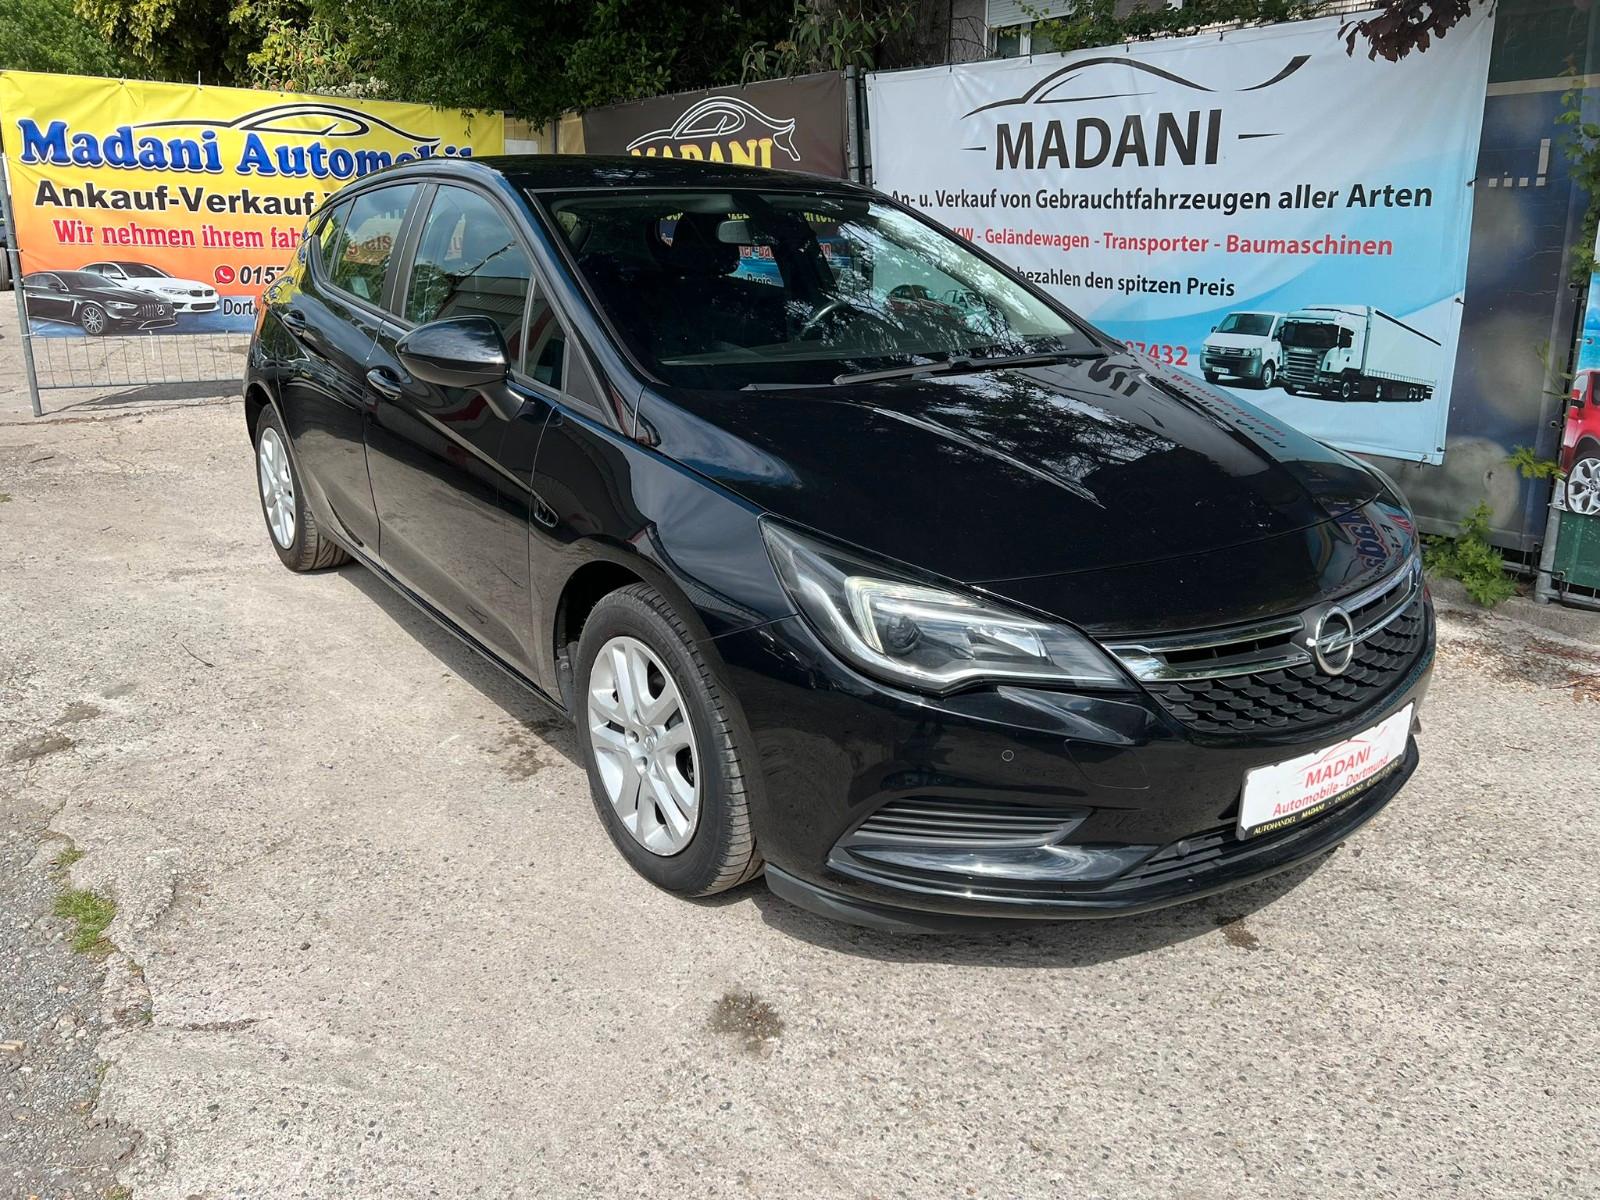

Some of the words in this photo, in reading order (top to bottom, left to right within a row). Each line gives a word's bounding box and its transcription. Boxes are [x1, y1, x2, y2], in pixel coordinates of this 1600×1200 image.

[19, 119, 225, 174] Madani
[995, 109, 1222, 170] MADANI
[35, 180, 315, 216] Ankauf-Verkauf
[919, 193, 932, 208] u.
[935, 189, 997, 208] Verkauf
[1000, 191, 1031, 209] von
[1035, 186, 1270, 215] Gebrauchtfahrzeugen
[1277, 184, 1338, 209] aller
[1345, 182, 1433, 209] Arten
[53, 220, 94, 244] Wir
[101, 223, 196, 246] nehmen
[201, 226, 264, 248] ihrem
[985, 228, 1090, 251] Geländewagen
[1103, 232, 1209, 254] Transporter
[1226, 233, 1394, 256] Baumaschinen
[1084, 272, 1114, 290] den
[1117, 274, 1181, 298] spitzen
[1187, 276, 1236, 297] Preis
[1273, 782, 1339, 817] Automobile
[1345, 753, 1389, 787] Dortmund
[1305, 746, 1372, 788] MADANI
